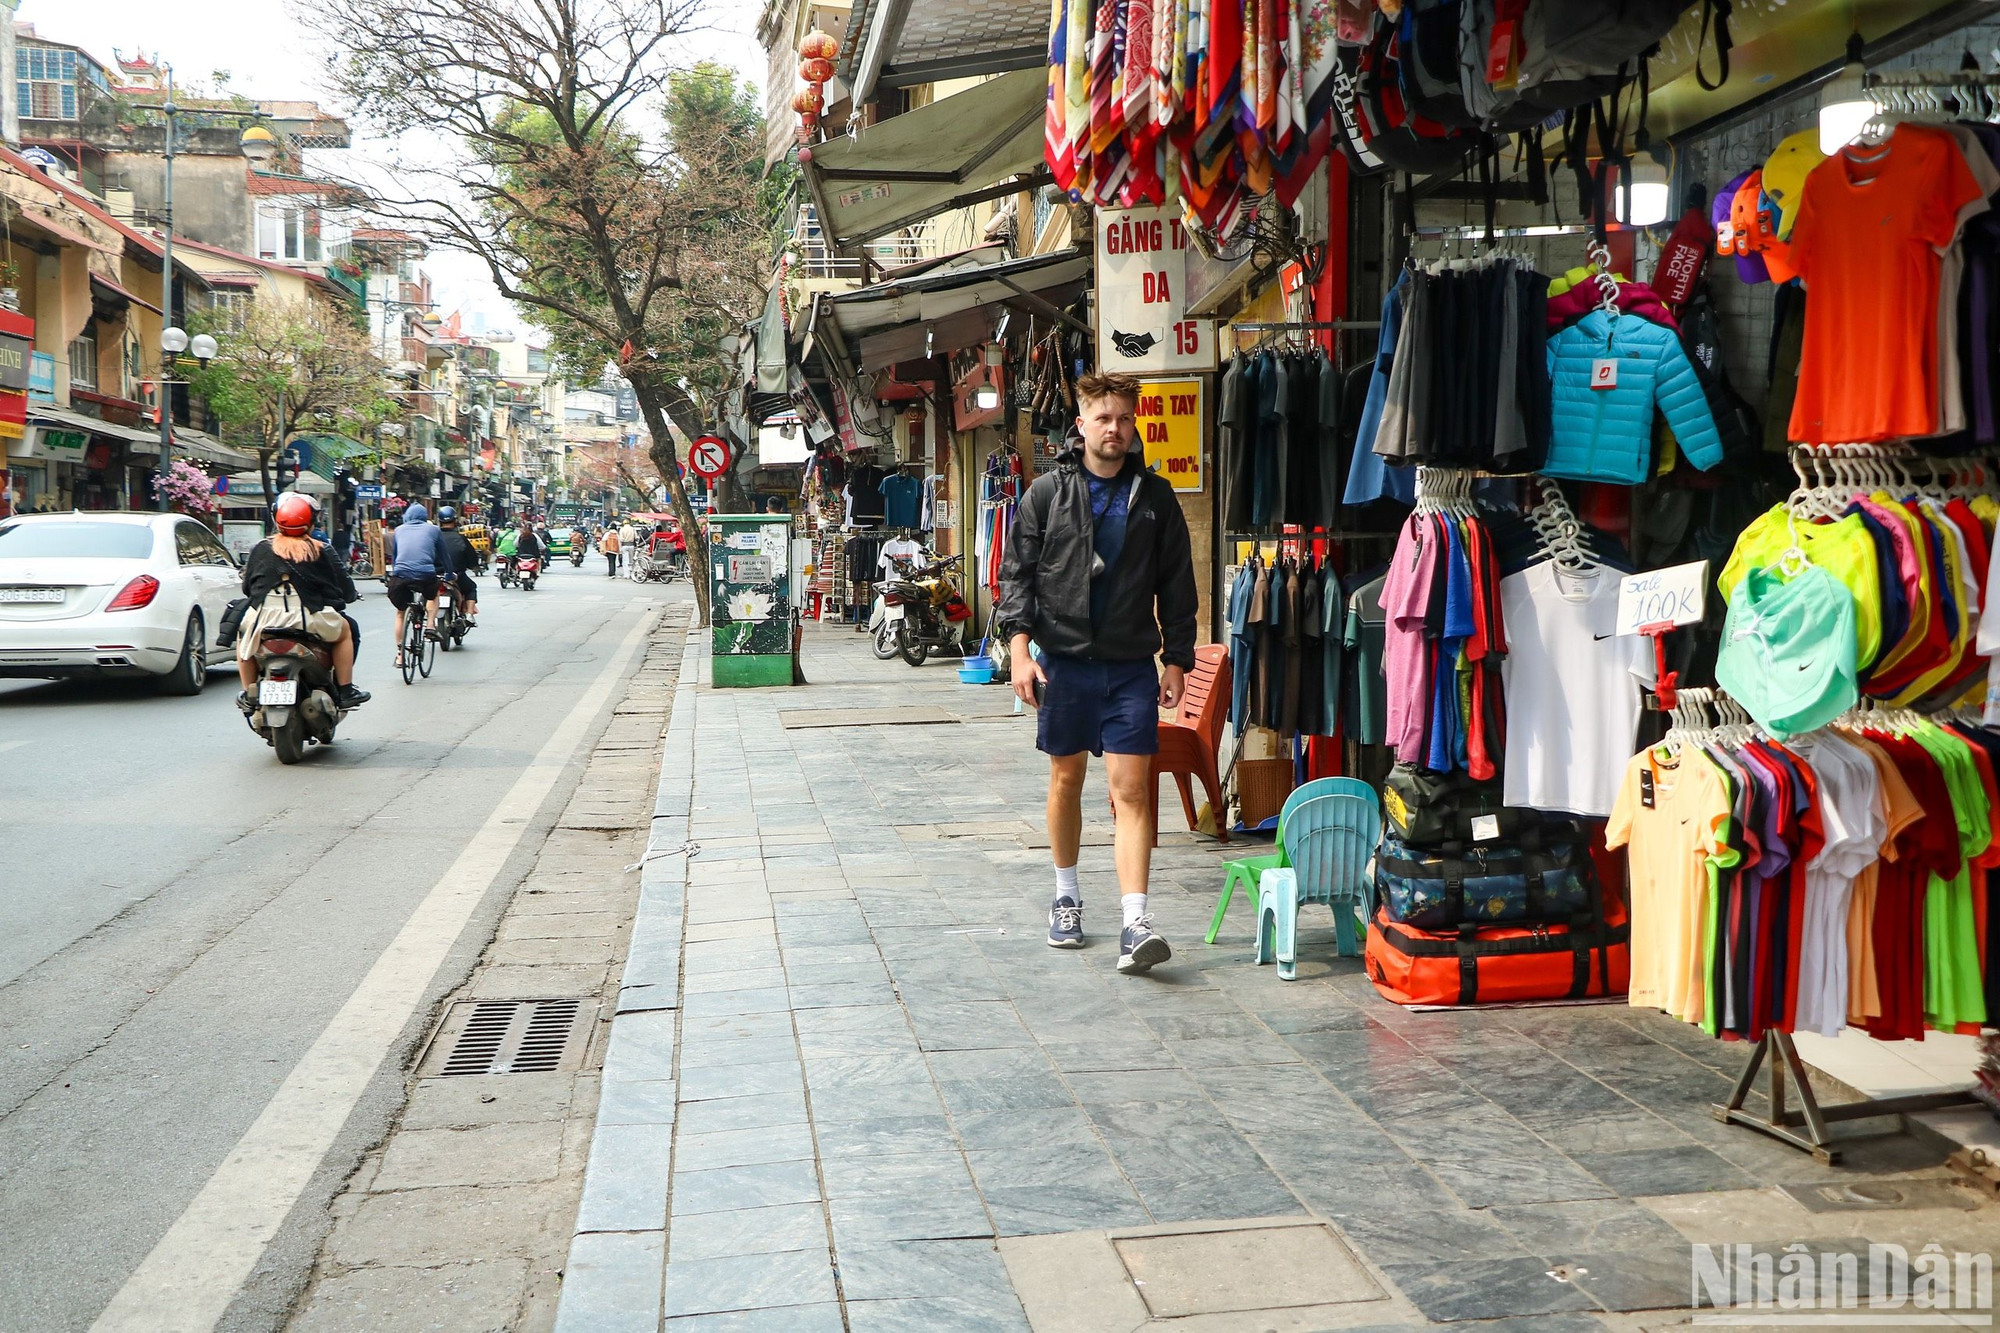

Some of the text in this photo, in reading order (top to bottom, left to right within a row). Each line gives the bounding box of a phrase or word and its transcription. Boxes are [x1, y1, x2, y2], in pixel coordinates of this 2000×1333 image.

[1106, 216, 1163, 255] GĂNG
[1667, 244, 1689, 278] FACE
[1671, 254, 1698, 301] NORTH
[1142, 271, 1171, 304] DA
[1173, 321, 1198, 355] 15
[1169, 394, 1197, 416] TAY
[1146, 422, 1169, 443] DA
[1166, 455, 1199, 474] 100%
[1626, 572, 1662, 594] Sale
[1631, 587, 1697, 628] 100K
[263, 693, 294, 703] 173.32
